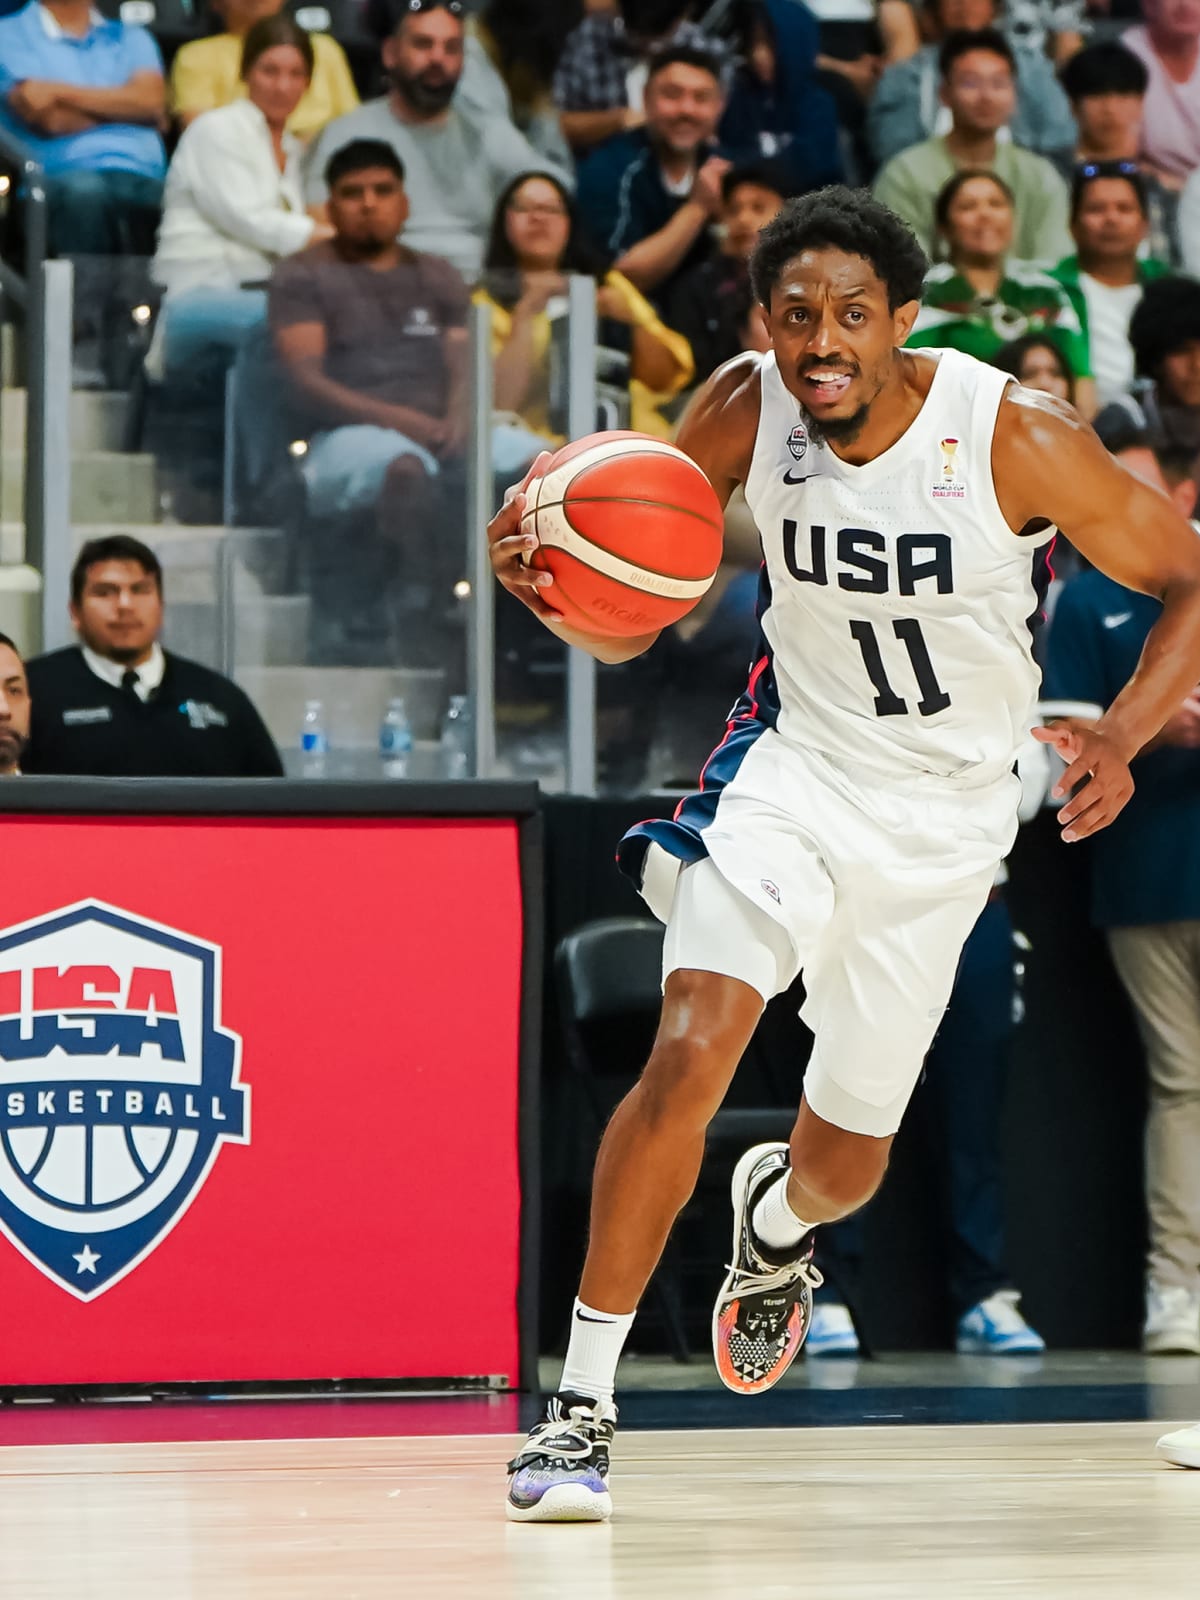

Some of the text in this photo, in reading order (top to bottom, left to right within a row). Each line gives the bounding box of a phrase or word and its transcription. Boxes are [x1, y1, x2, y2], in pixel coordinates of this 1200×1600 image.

[783, 518, 954, 596] USA
[849, 618, 952, 717] 11
[0, 965, 186, 1063] USA
[7, 1089, 227, 1121] SKETBALL
